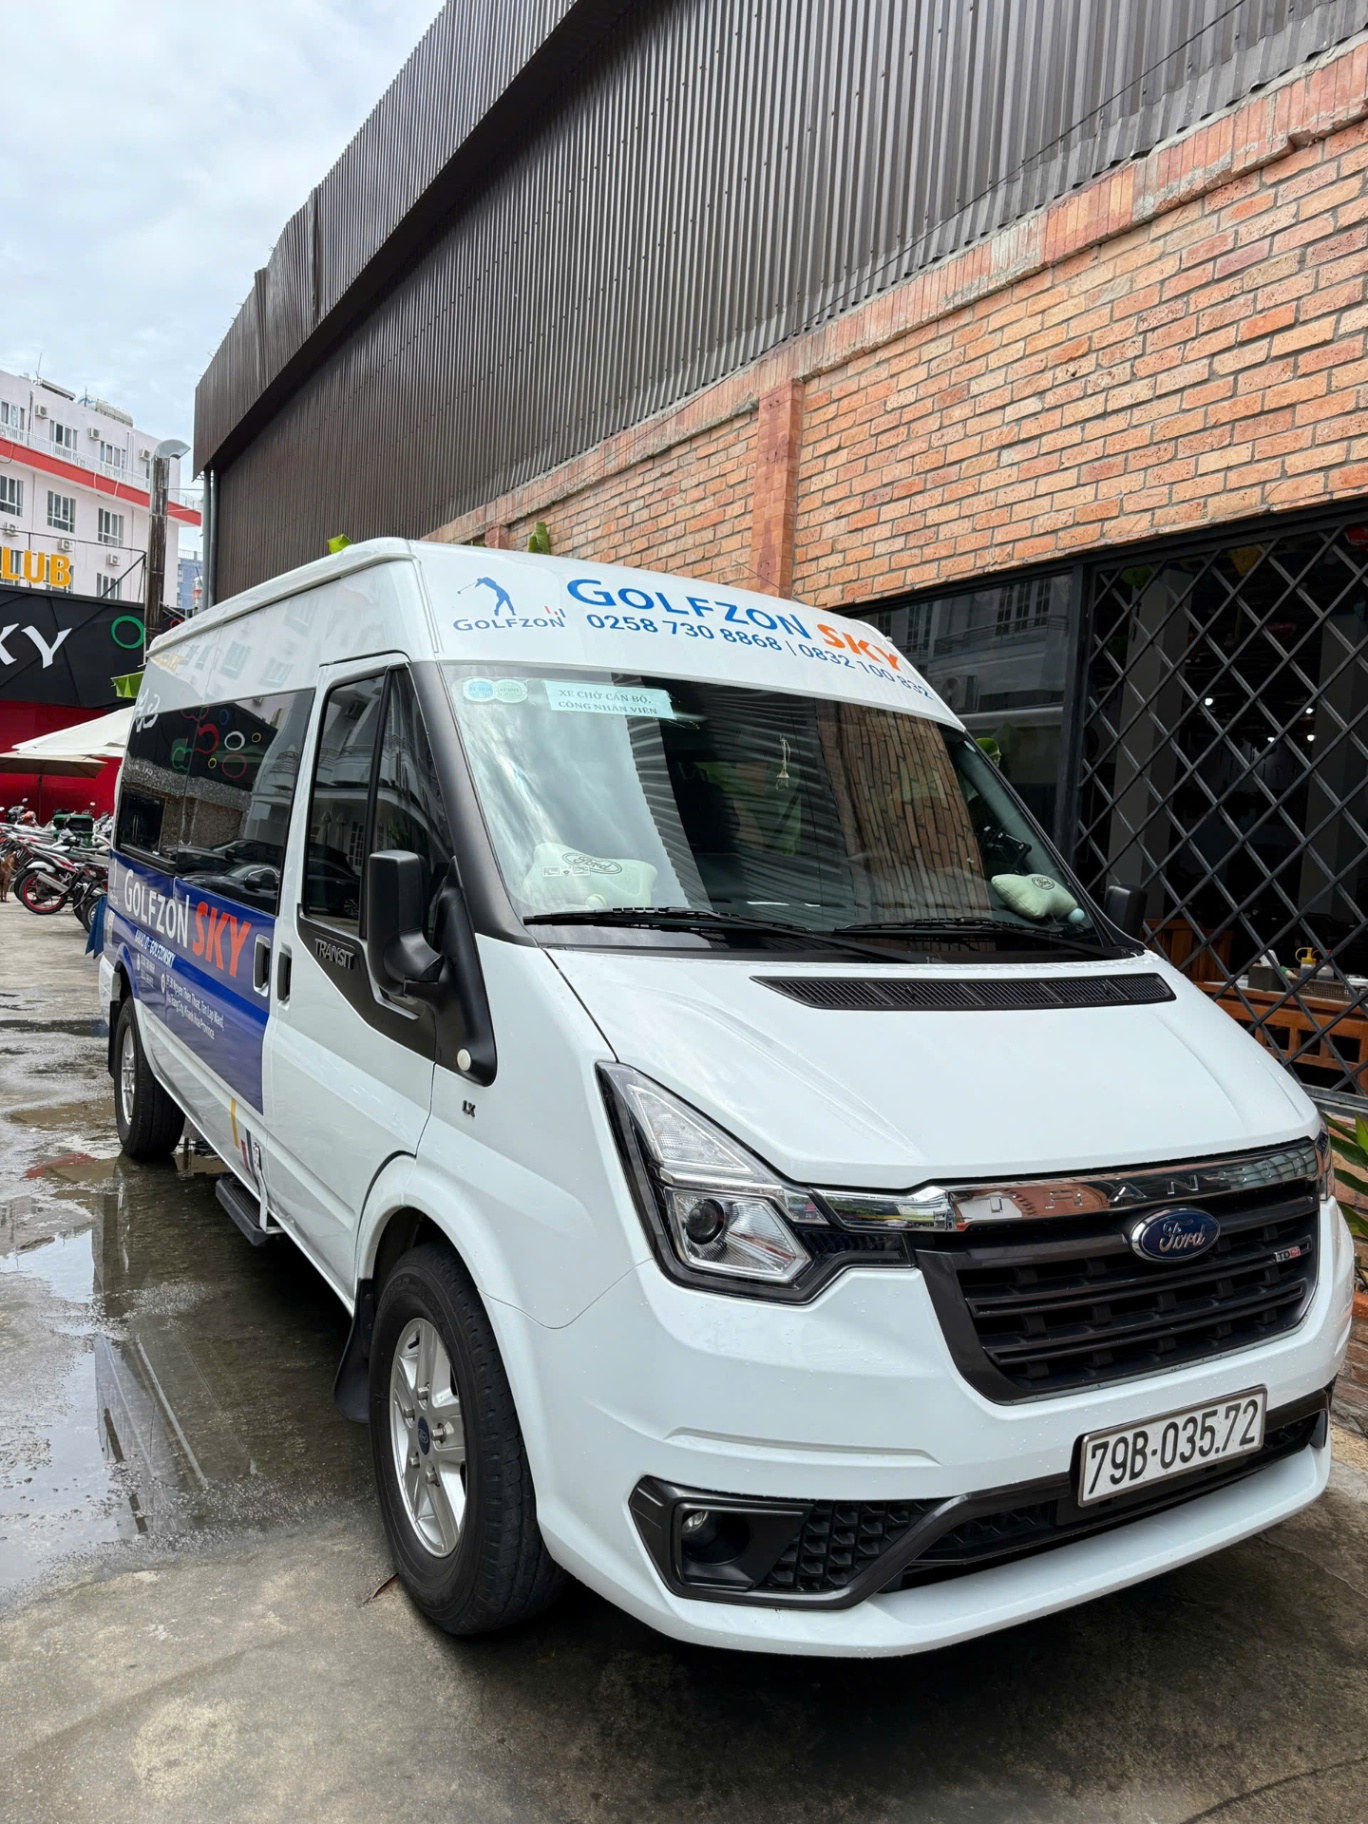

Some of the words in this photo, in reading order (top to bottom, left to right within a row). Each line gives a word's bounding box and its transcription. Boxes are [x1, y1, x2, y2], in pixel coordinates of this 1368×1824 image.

[1, 546, 71, 587] LUB
[453, 612, 566, 631] GOLFZON
[566, 578, 812, 641] GOLFZON
[816, 623, 902, 672] SKY
[587, 613, 658, 634] 0258
[662, 619, 715, 640] 730
[722, 627, 782, 652] 8868
[797, 643, 854, 668] 0832
[857, 660, 894, 680] 100
[124, 869, 190, 948] GOLFZON
[192, 902, 252, 978] SKY
[314, 938, 354, 969] TRANSIT
[462, 1100, 476, 1117] LX
[1158, 1219, 1207, 1251] Ford
[1088, 1398, 1259, 1495] 79B-035.72
